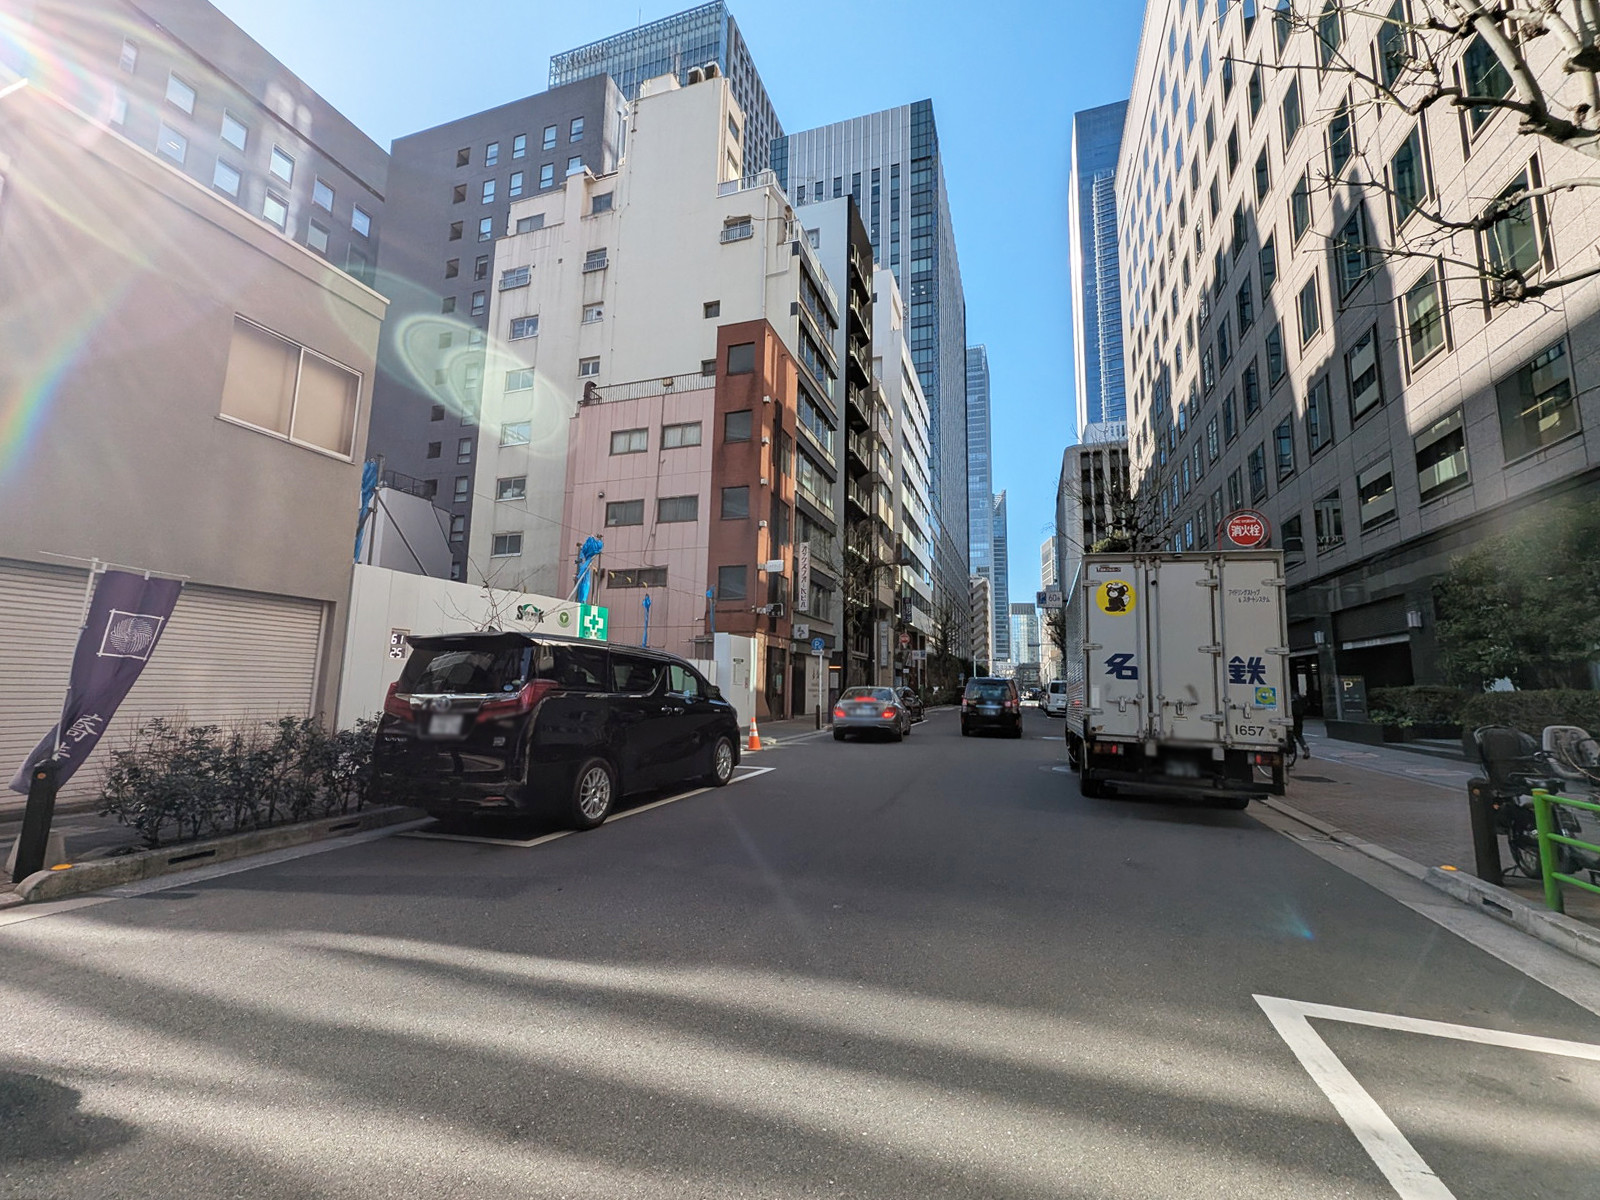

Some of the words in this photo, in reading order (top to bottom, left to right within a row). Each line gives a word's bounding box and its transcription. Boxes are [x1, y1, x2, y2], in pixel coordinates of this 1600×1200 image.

[1231, 524, 1260, 537] 消火栓
[391, 634, 404, 644] 61
[390, 648, 402, 658] 25
[1104, 653, 1138, 680] 名
[1228, 656, 1266, 685] 鉄
[1344, 681, 1353, 691] P
[1235, 725, 1264, 736] 1657
